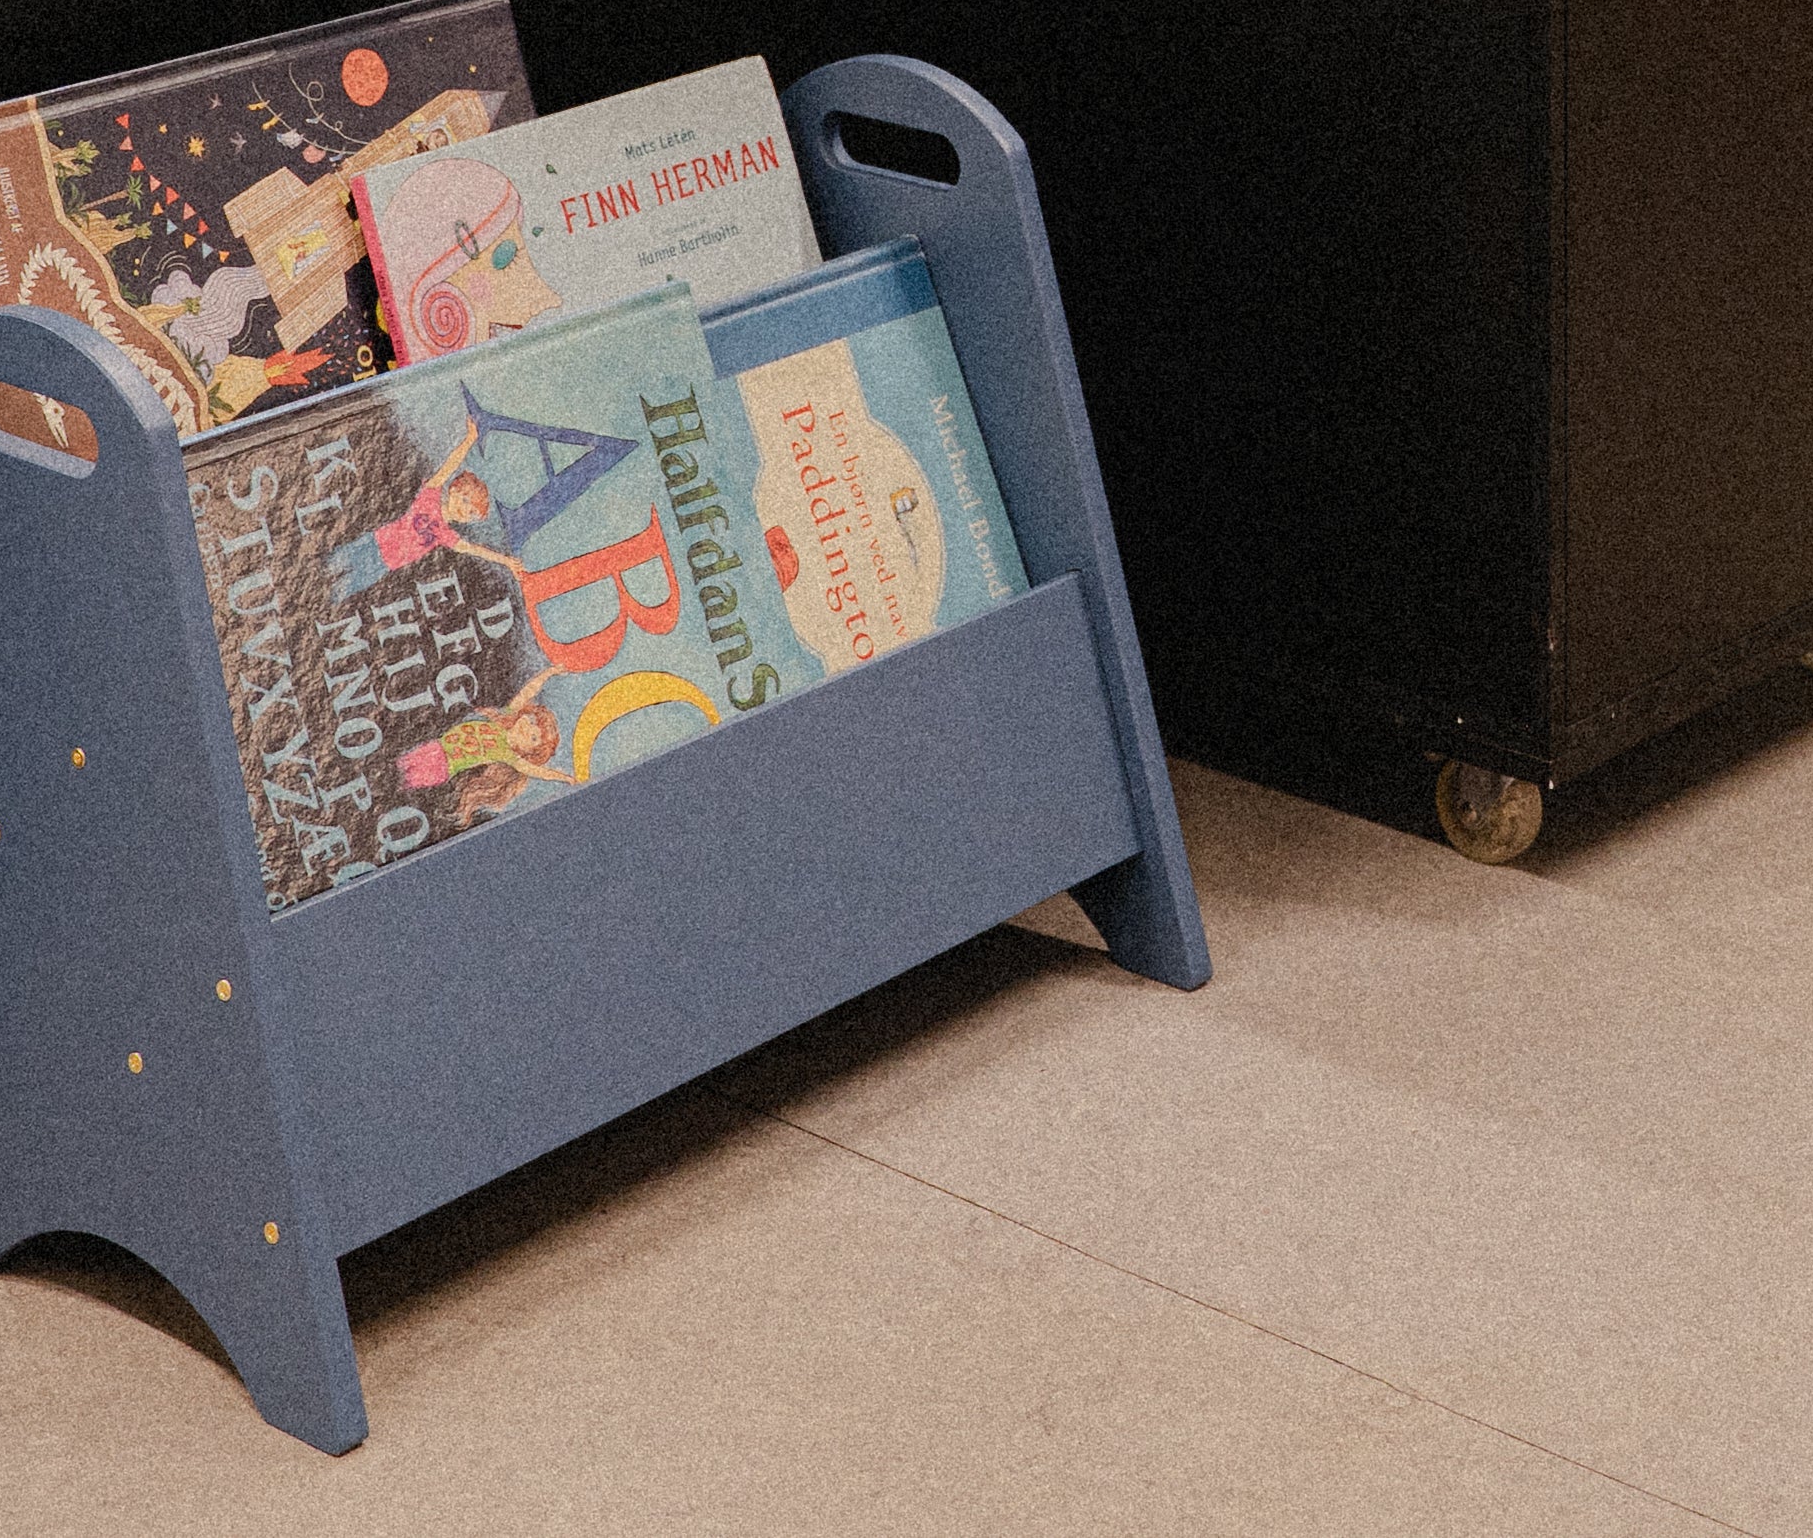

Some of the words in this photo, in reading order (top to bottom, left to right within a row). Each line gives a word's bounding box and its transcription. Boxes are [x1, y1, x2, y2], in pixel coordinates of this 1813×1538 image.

[559, 179, 642, 236] FINN
[650, 135, 781, 207] HERMAN
[624, 139, 658, 160] Mats
[637, 244, 677, 269] Hanne
[679, 223, 740, 256] Bartholin
[638, 381, 782, 713] Halfdans
[827, 410, 849, 448] En
[841, 454, 874, 529] bjørn
[868, 538, 897, 584] ved
[929, 393, 985, 511] Michael
[966, 516, 1012, 599] Bond
